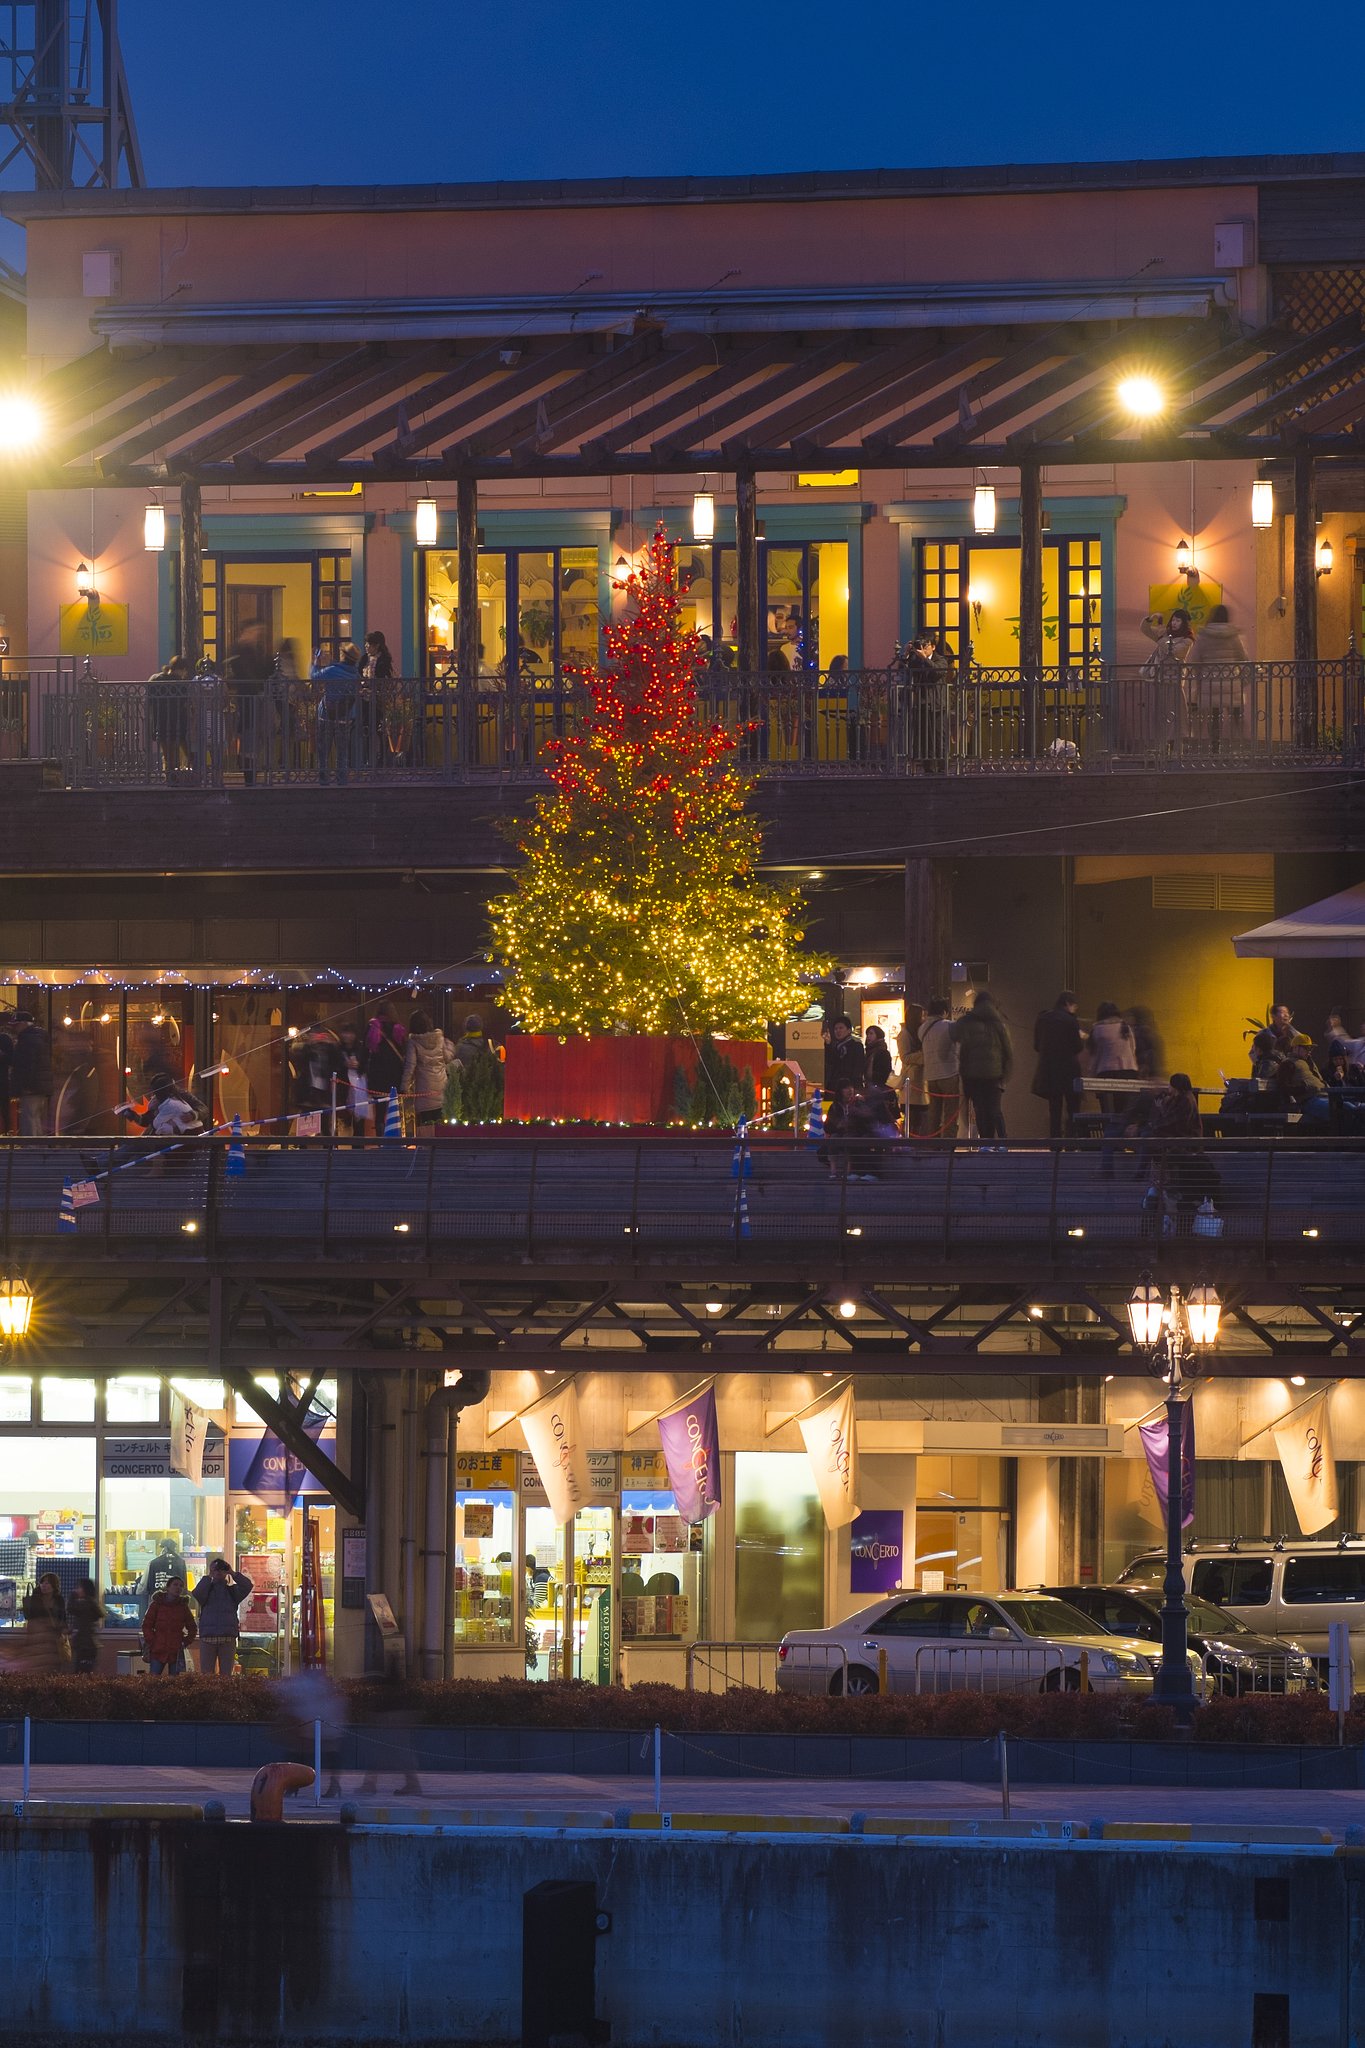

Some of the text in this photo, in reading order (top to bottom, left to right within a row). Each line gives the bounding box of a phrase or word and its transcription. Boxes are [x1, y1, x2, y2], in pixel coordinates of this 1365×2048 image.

[114, 1443, 161, 1453] コンチェルト
[457, 1455, 502, 1471] のお土産
[110, 1464, 165, 1475] CONCERTO
[591, 1477, 613, 1488] SHOP
[854, 1543, 899, 1560] CONCERTO
[664, 1816, 670, 1828] 5
[1062, 1825, 1071, 1837] 10
